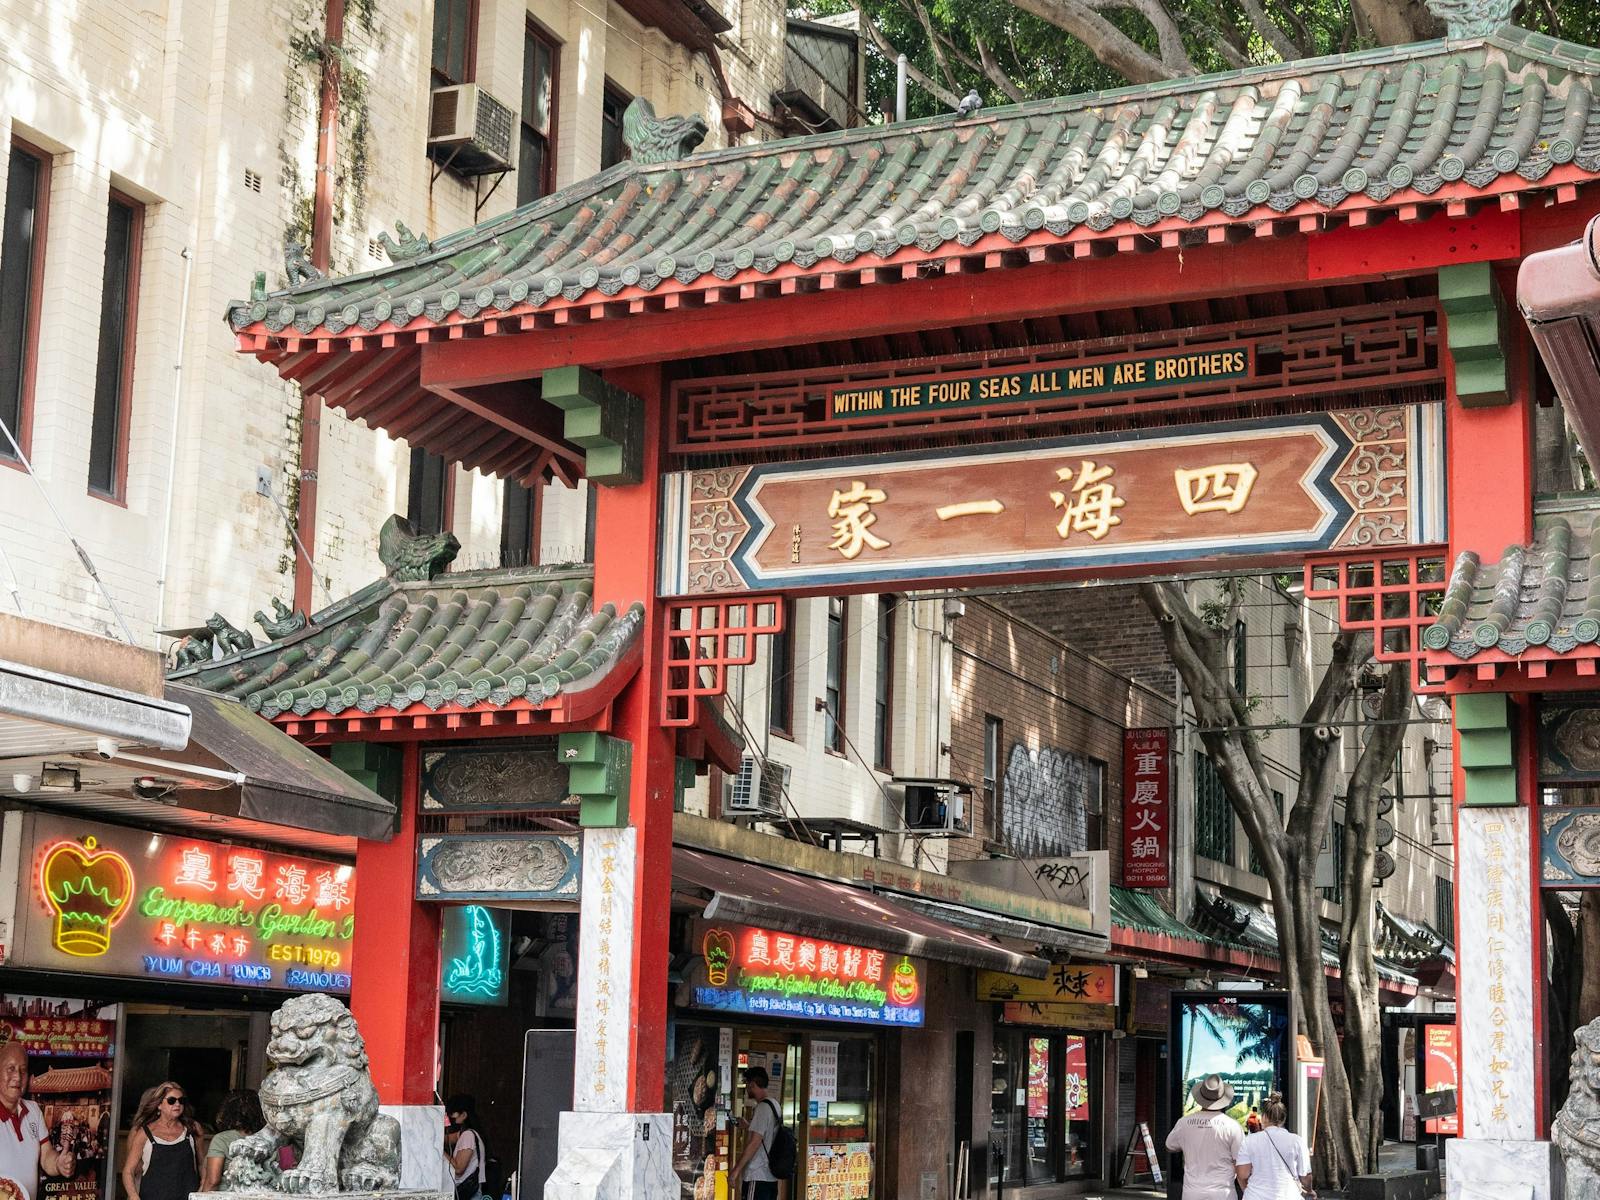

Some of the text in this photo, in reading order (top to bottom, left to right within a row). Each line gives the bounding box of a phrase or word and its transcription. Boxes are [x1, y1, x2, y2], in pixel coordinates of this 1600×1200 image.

[834, 351, 1245, 414] WITHIN THE FOUR SEAS ALL MEN ARE BROTHERS
[1130, 751, 1162, 859] 重慶火鍋
[175, 847, 351, 911] 皇冠海鮮
[143, 887, 254, 926] Emperor's
[259, 904, 336, 939] Garden
[147, 956, 182, 973] YUM
[190, 960, 221, 977] CHA
[225, 964, 271, 981] LUNCH
[785, 974, 818, 998] Garden
[819, 978, 845, 998] Cakes
[853, 982, 886, 1006] Bakery
[45, 1181, 97, 1192] GREAT VALUE
